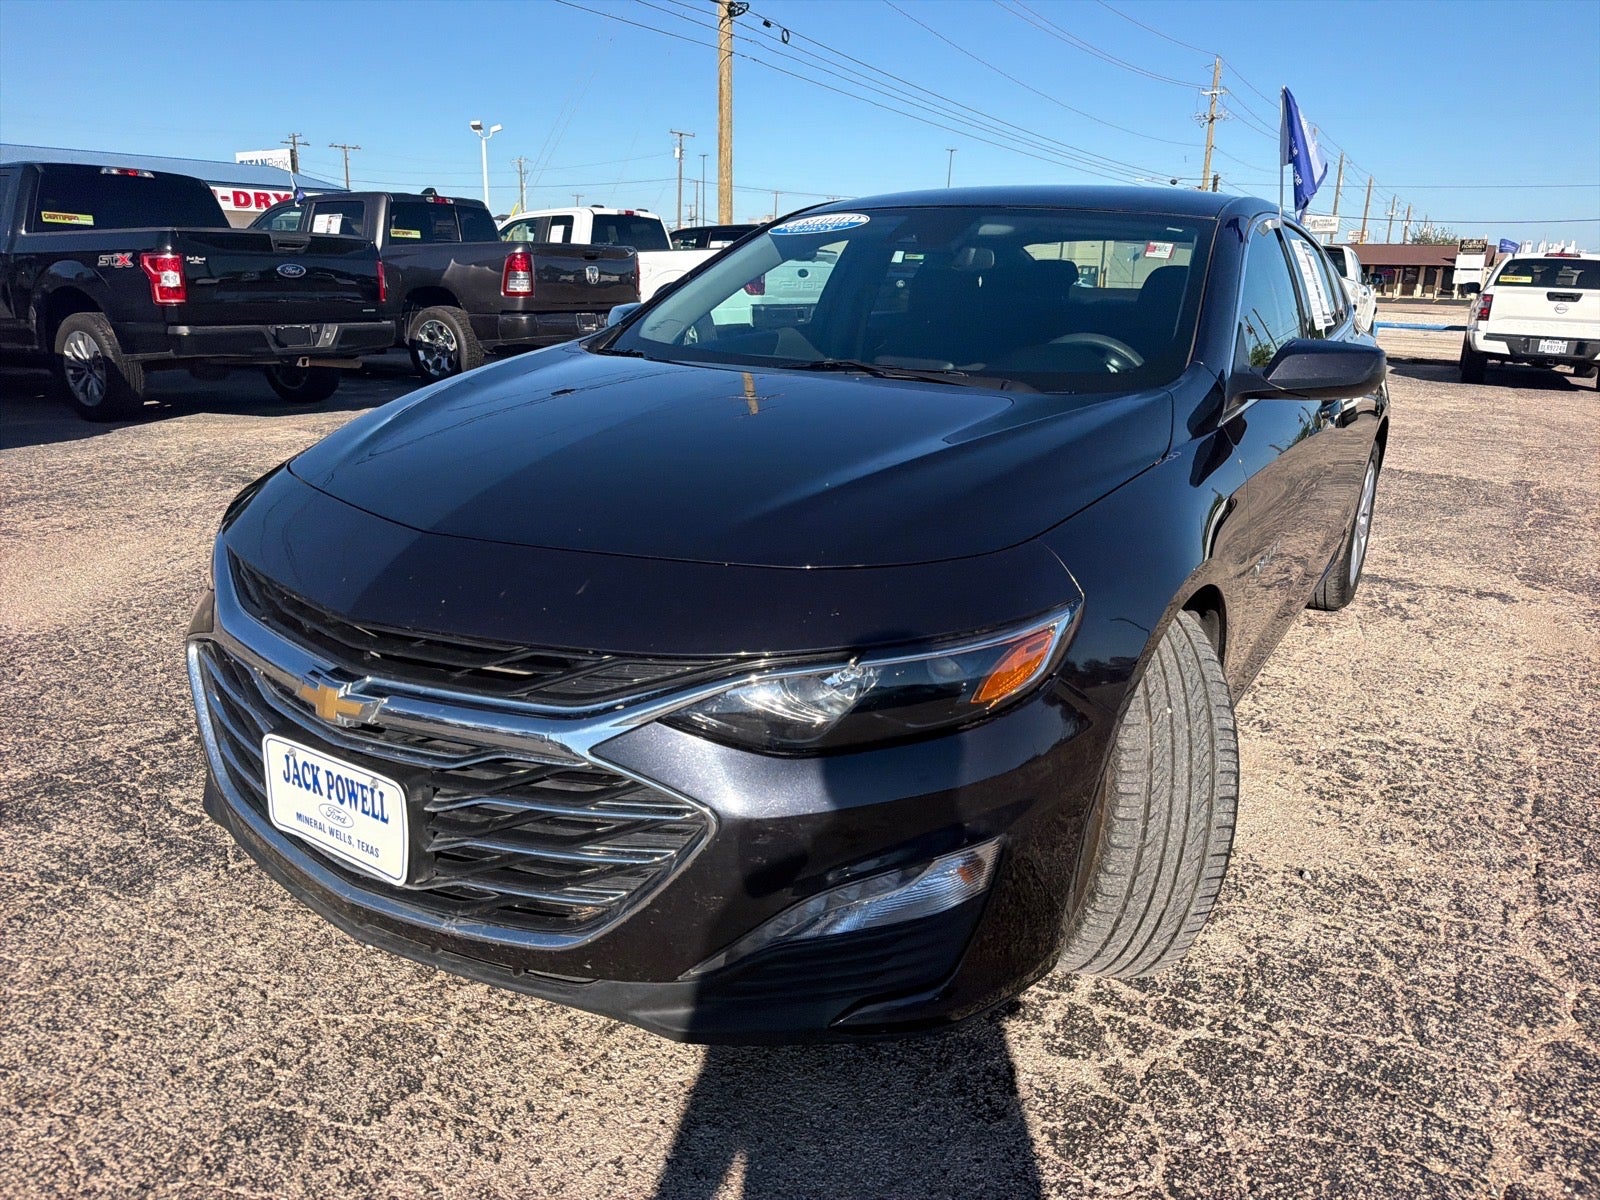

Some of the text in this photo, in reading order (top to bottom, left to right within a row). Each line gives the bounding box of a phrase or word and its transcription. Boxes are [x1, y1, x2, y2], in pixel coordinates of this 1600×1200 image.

[240, 156, 290, 170] ANBank
[97, 252, 134, 268] STX
[283, 755, 389, 824] JACK POWELL
[325, 806, 347, 825] Ford
[296, 812, 379, 858] MINERAL WELLS, TEXAS
